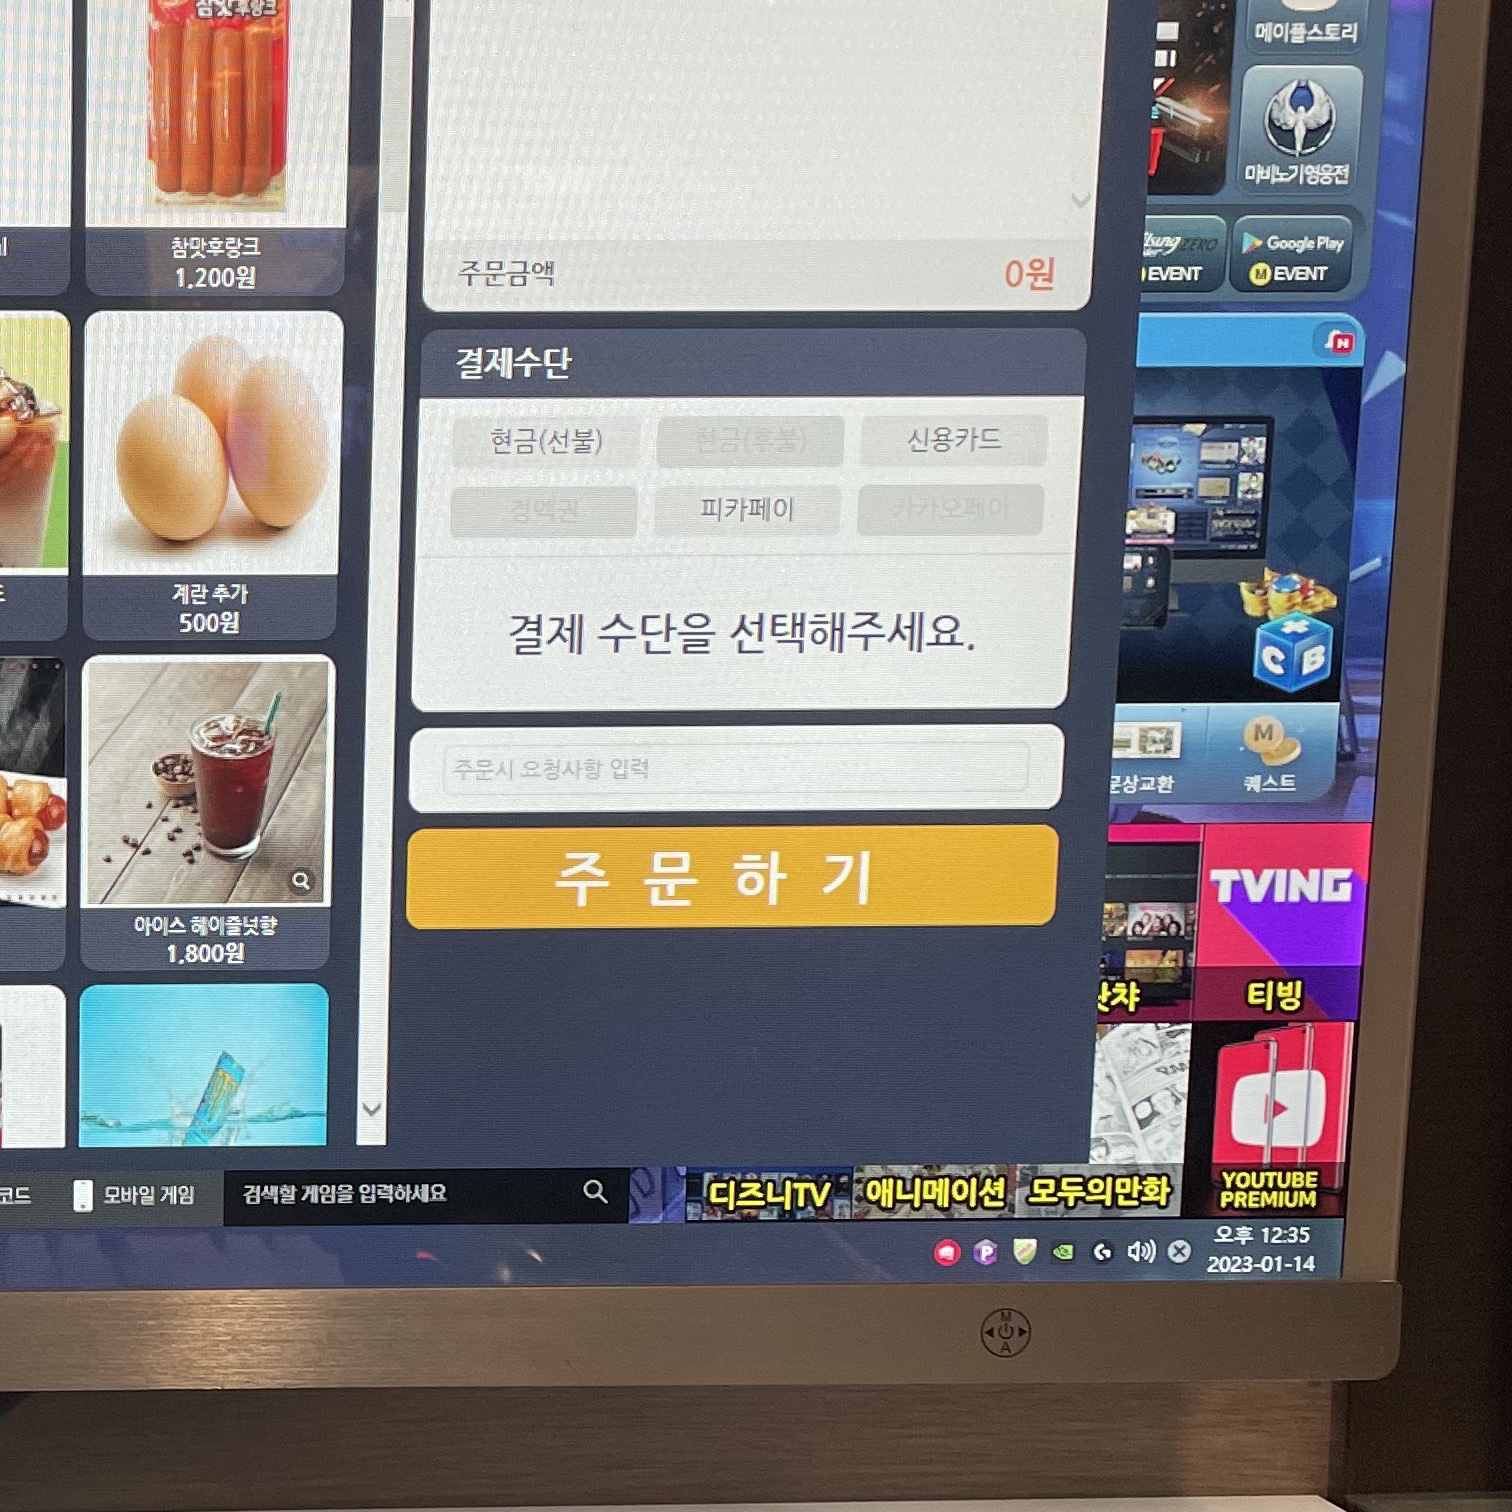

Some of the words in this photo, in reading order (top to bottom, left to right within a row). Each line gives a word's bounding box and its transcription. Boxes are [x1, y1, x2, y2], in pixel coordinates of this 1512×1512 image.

[1255, 22, 1358, 43] 메이플스토리
[1245, 164, 1350, 185] 마비노기영웅전
[171, 236, 261, 260] 참맛후랑크
[1268, 235, 1316, 253] Google
[1317, 236, 1345, 253] Play
[175, 266, 256, 290] 1,200원
[458, 260, 556, 288] 주문금액
[1004, 256, 1056, 290] 0원
[1149, 266, 1204, 281] EVENT
[1274, 266, 1329, 281] EVENT
[456, 346, 572, 380] 결제수단
[490, 427, 603, 456] 현금(선불)
[908, 426, 1003, 453] 신용카드
[701, 497, 794, 523] 피카페이
[171, 583, 208, 605] 계란
[211, 583, 249, 605] 추가
[179, 611, 240, 634] 500원
[509, 612, 584, 656] 결제
[597, 612, 716, 655] 수단을
[730, 609, 976, 655] 선택해주세요.
[452, 758, 514, 782] 주문시
[520, 758, 604, 782] 요청사항
[609, 757, 650, 781] 입력
[1244, 775, 1297, 793] 퀘스트
[1210, 868, 1354, 903] TVING
[133, 916, 186, 937] 아이스
[189, 915, 278, 937] 헤이즐넛향
[167, 942, 246, 965] 1,800원
[1247, 980, 1303, 1012] 티빙
[1028, 1175, 1171, 1208] 모두의만화
[1221, 1171, 1318, 1190] YOUTUBE
[104, 1184, 156, 1206] 모바일
[160, 1184, 196, 1206] 게임
[242, 1183, 297, 1205] 검색할
[301, 1183, 355, 1205] 게임을
[359, 1183, 447, 1204] 입력하세요
[708, 1177, 832, 1212] 디즈니TV
[865, 1176, 1006, 1209] 애니메이션
[1220, 1191, 1317, 1209] PREMIUM
[1213, 1226, 1254, 1246] 오후
[1262, 1227, 1310, 1244] 12:35
[1207, 1256, 1315, 1274] 2023-01-14
